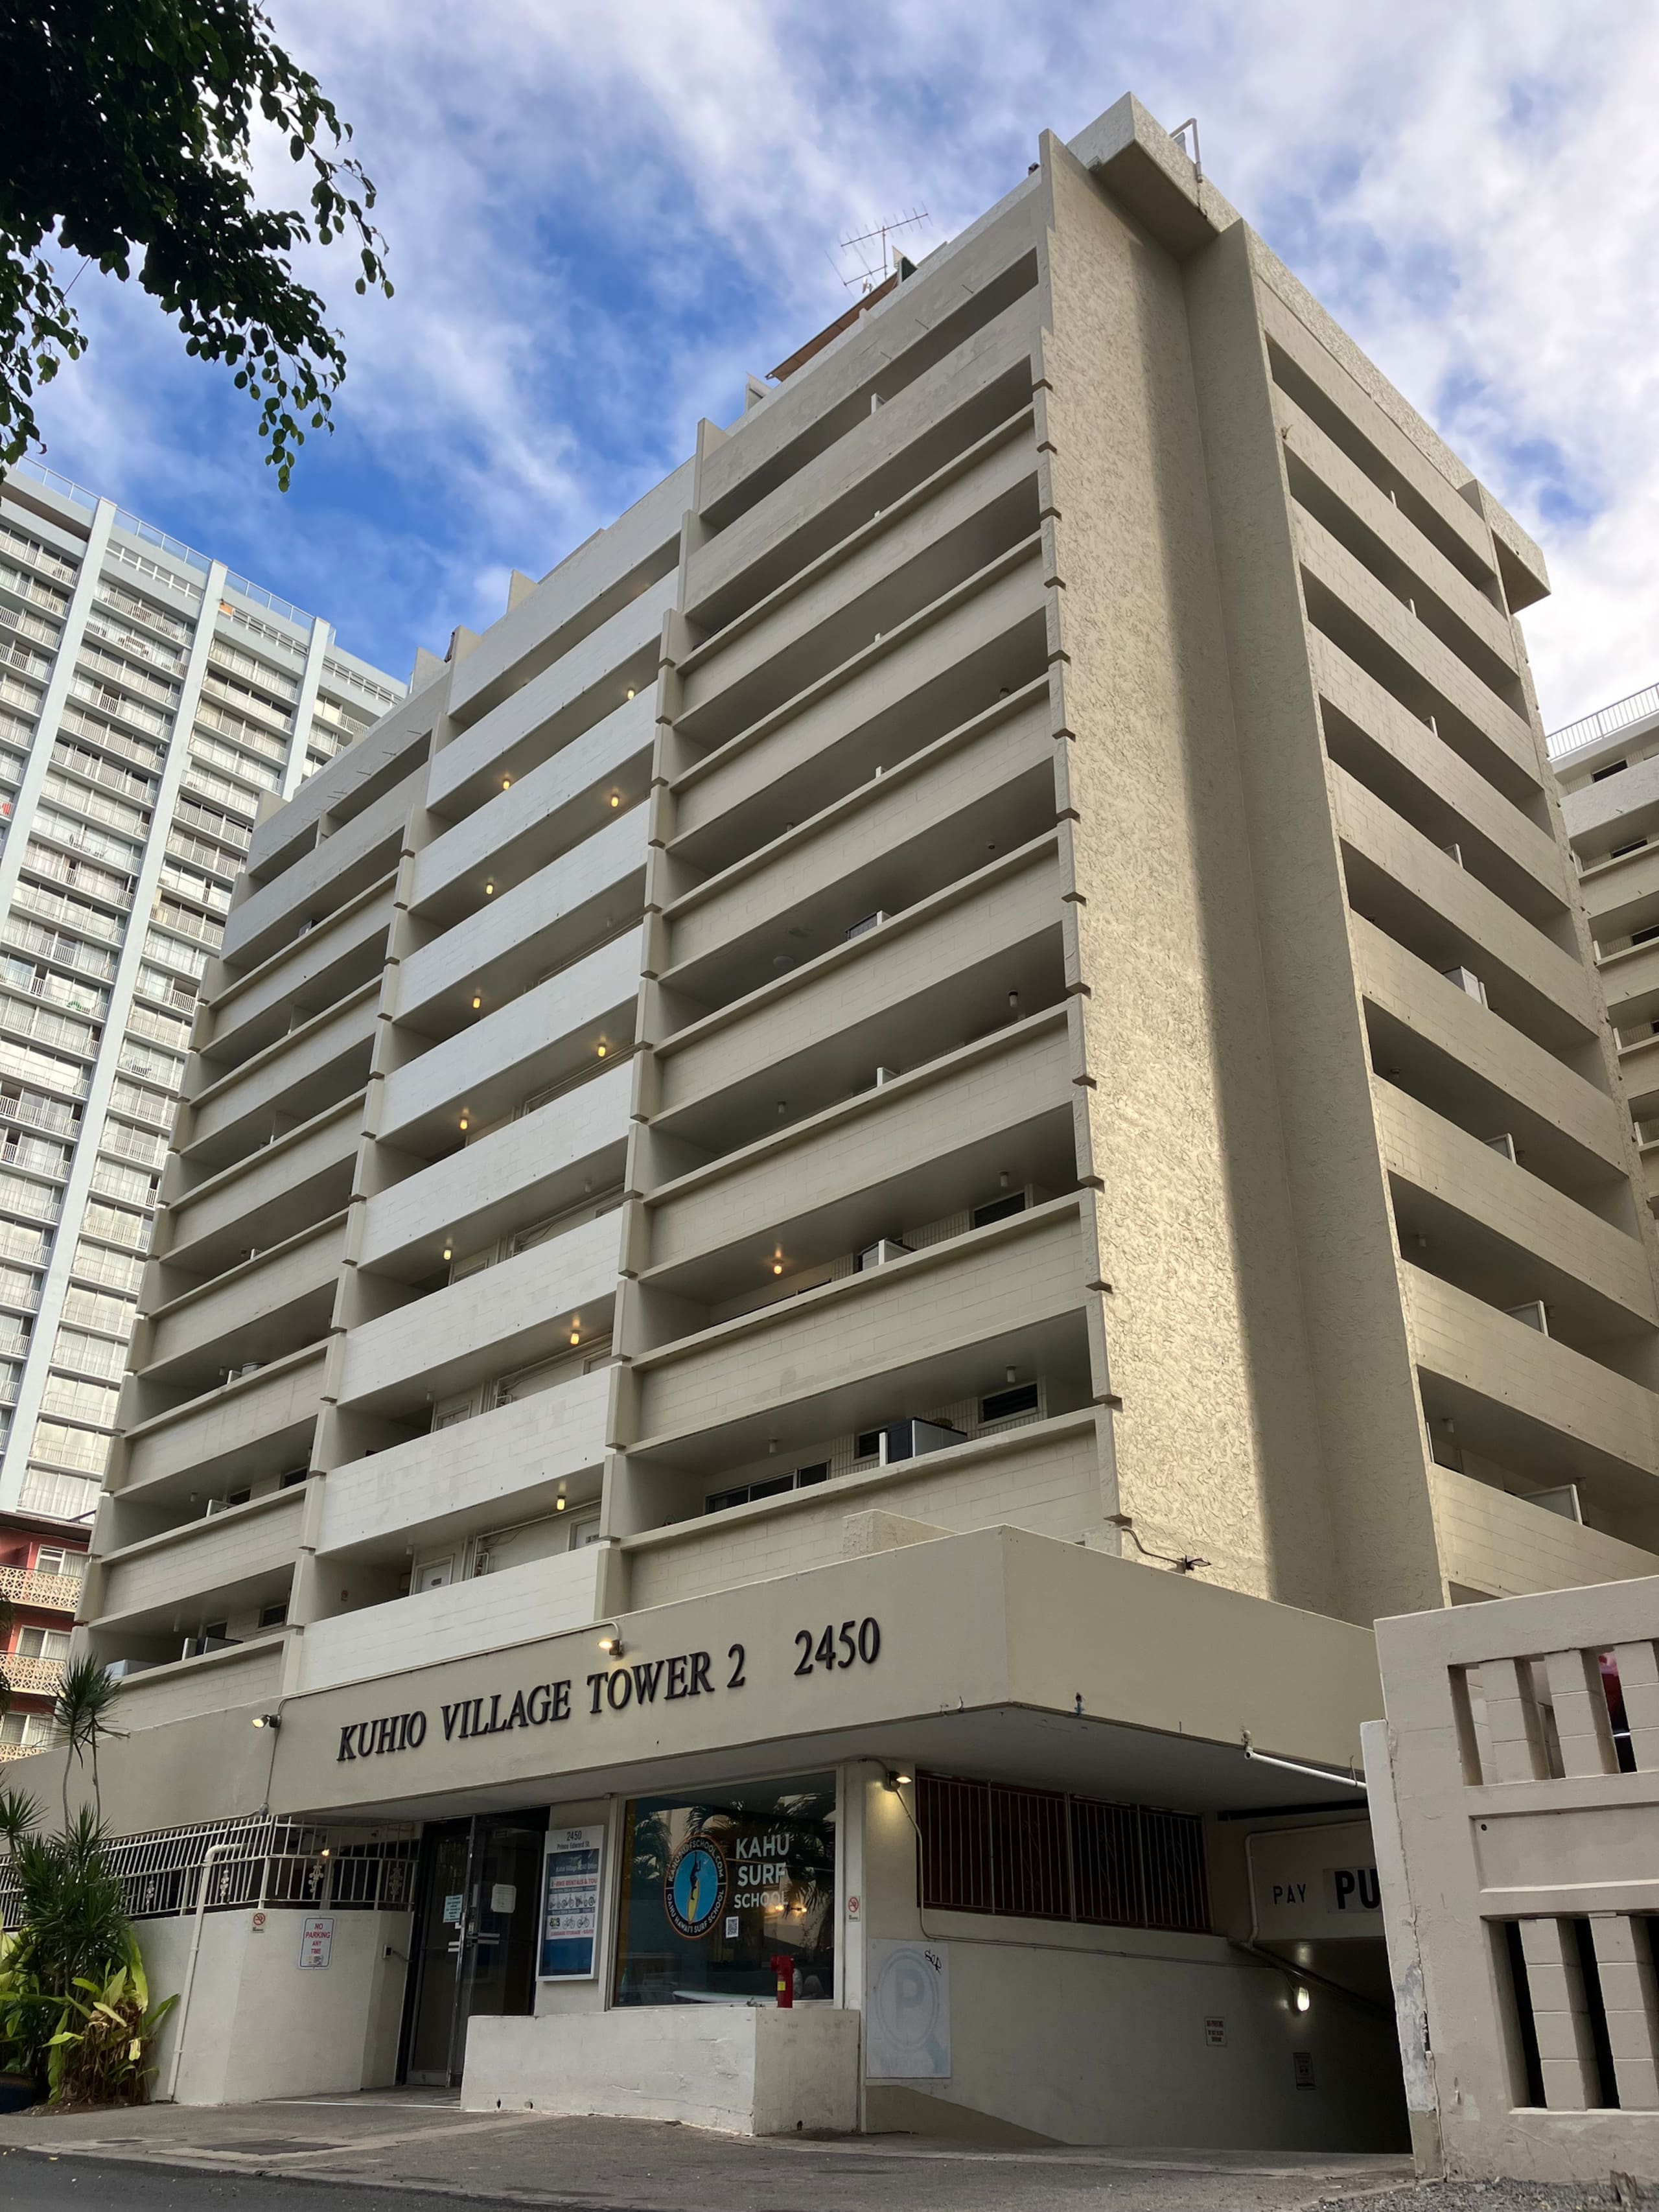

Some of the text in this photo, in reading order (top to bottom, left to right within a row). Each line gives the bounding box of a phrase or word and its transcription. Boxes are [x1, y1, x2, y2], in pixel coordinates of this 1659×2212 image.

[794, 1618, 880, 1676] 2450
[336, 1643, 746, 1762] KUHIO VILLAGE TOWER 2
[566, 1830, 582, 1841] 2450
[736, 1834, 790, 1859] KAHU
[737, 1861, 786, 1887] SURF
[734, 1891, 789, 1909] SCHOOL
[1273, 1883, 1306, 1905] PAY
[667, 1893, 676, 1918] OAHU
[693, 1921, 708, 1933] SURF
[708, 1889, 725, 1923] SCHOOL
